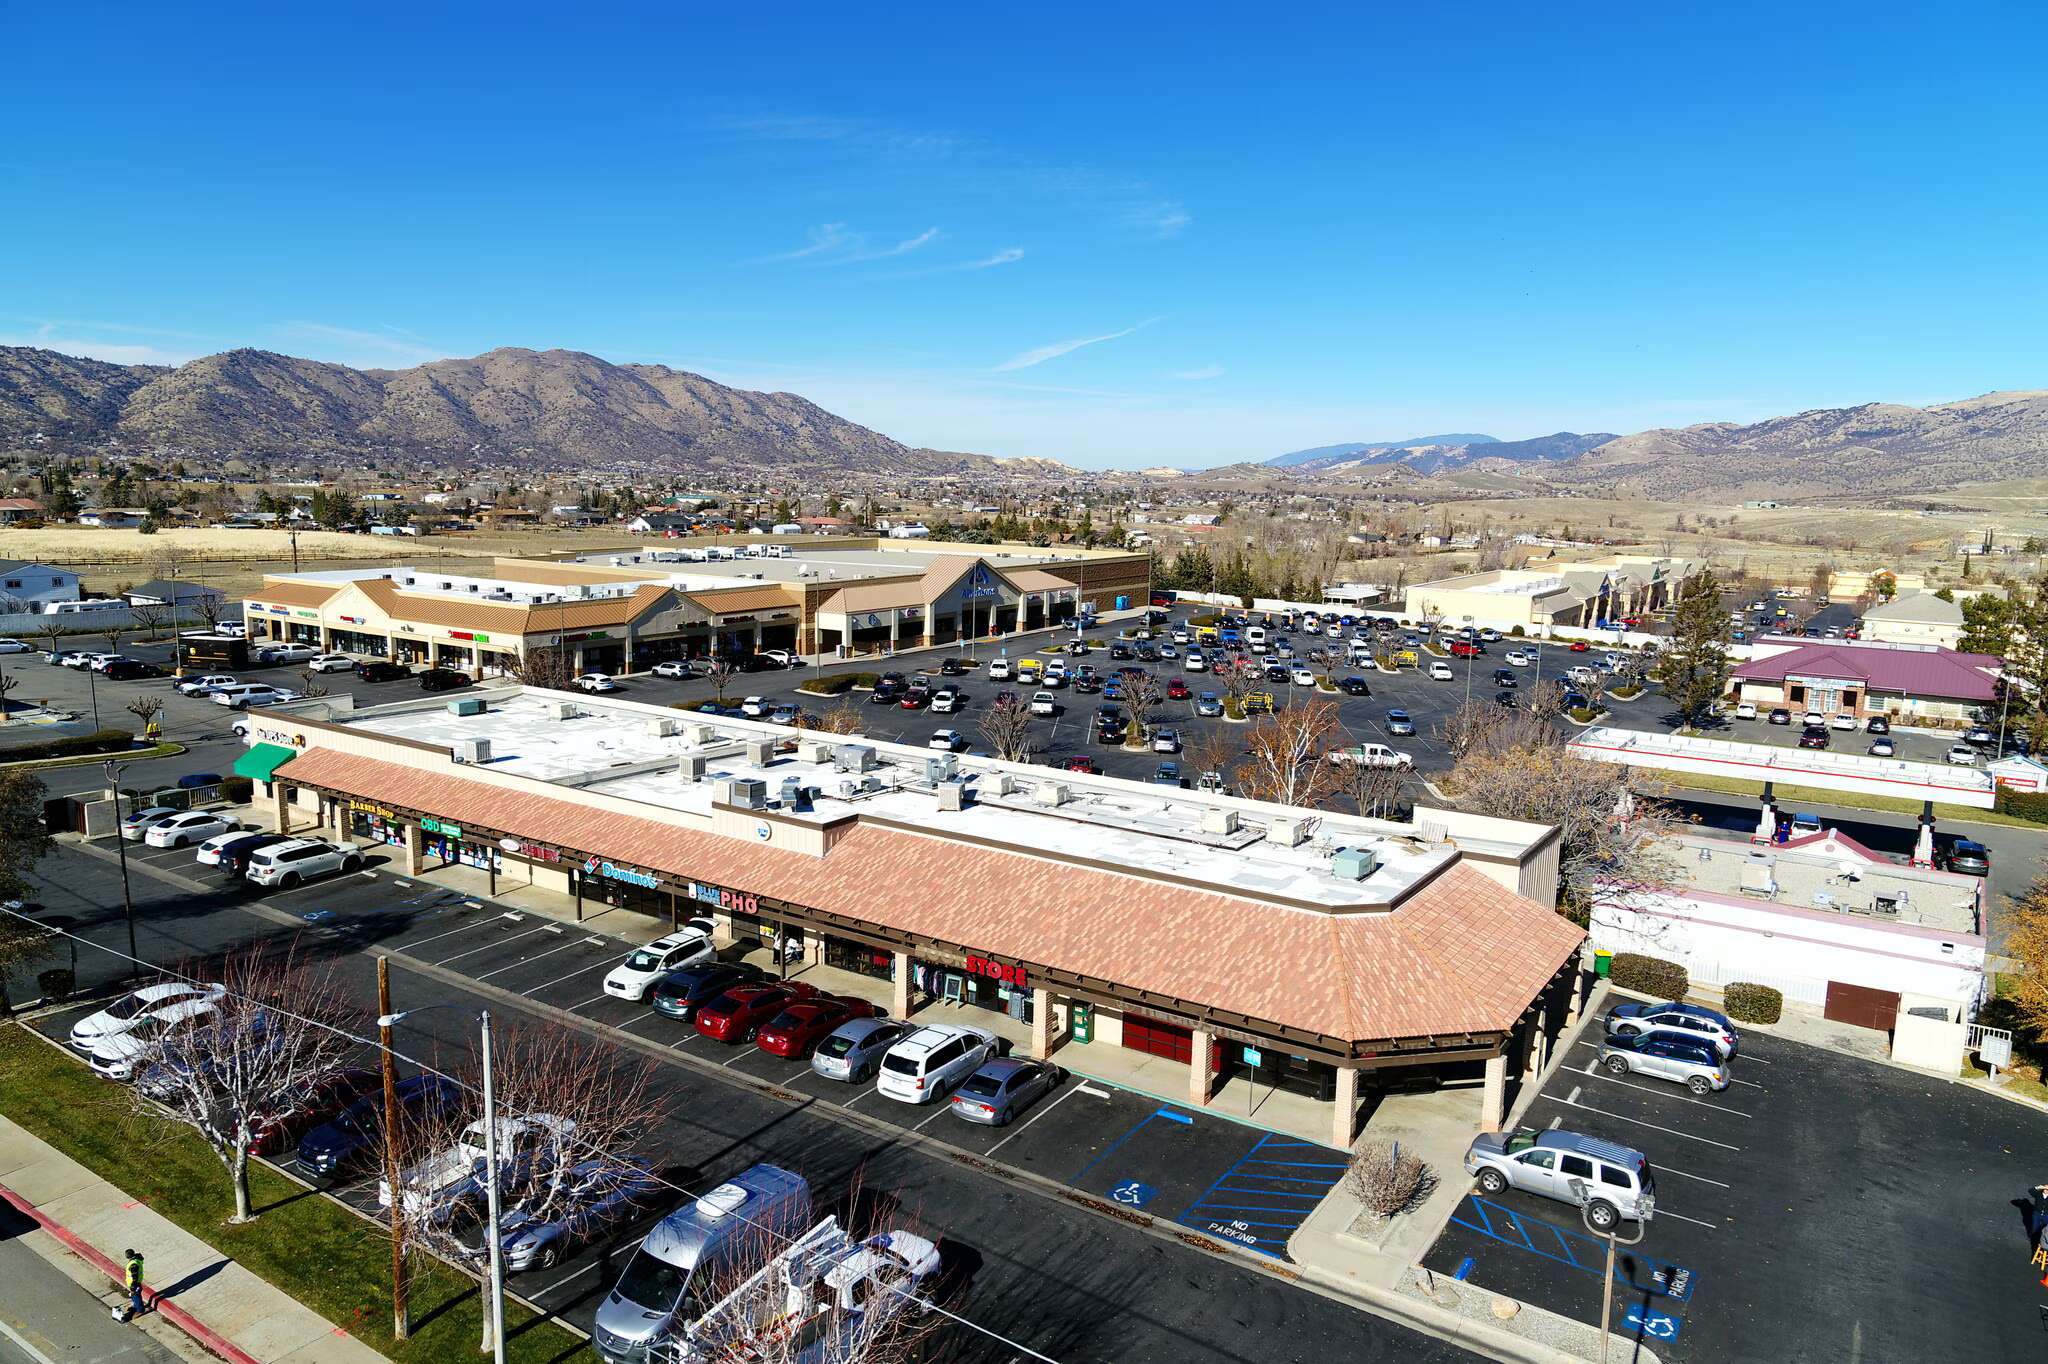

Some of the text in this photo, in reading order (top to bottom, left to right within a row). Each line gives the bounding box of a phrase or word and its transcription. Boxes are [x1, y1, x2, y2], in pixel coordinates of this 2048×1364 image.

[267, 730, 279, 742] UPS
[350, 799, 395, 819] BARBER SHOP
[421, 818, 440, 832] CBD
[602, 861, 658, 889] Domino's
[966, 955, 1027, 987] STORE
[1208, 1222, 1257, 1244] PARKING
[1231, 1220, 1249, 1231] NO
[1652, 1271, 1667, 1283] NO
[1668, 1268, 1690, 1298] PARKING
